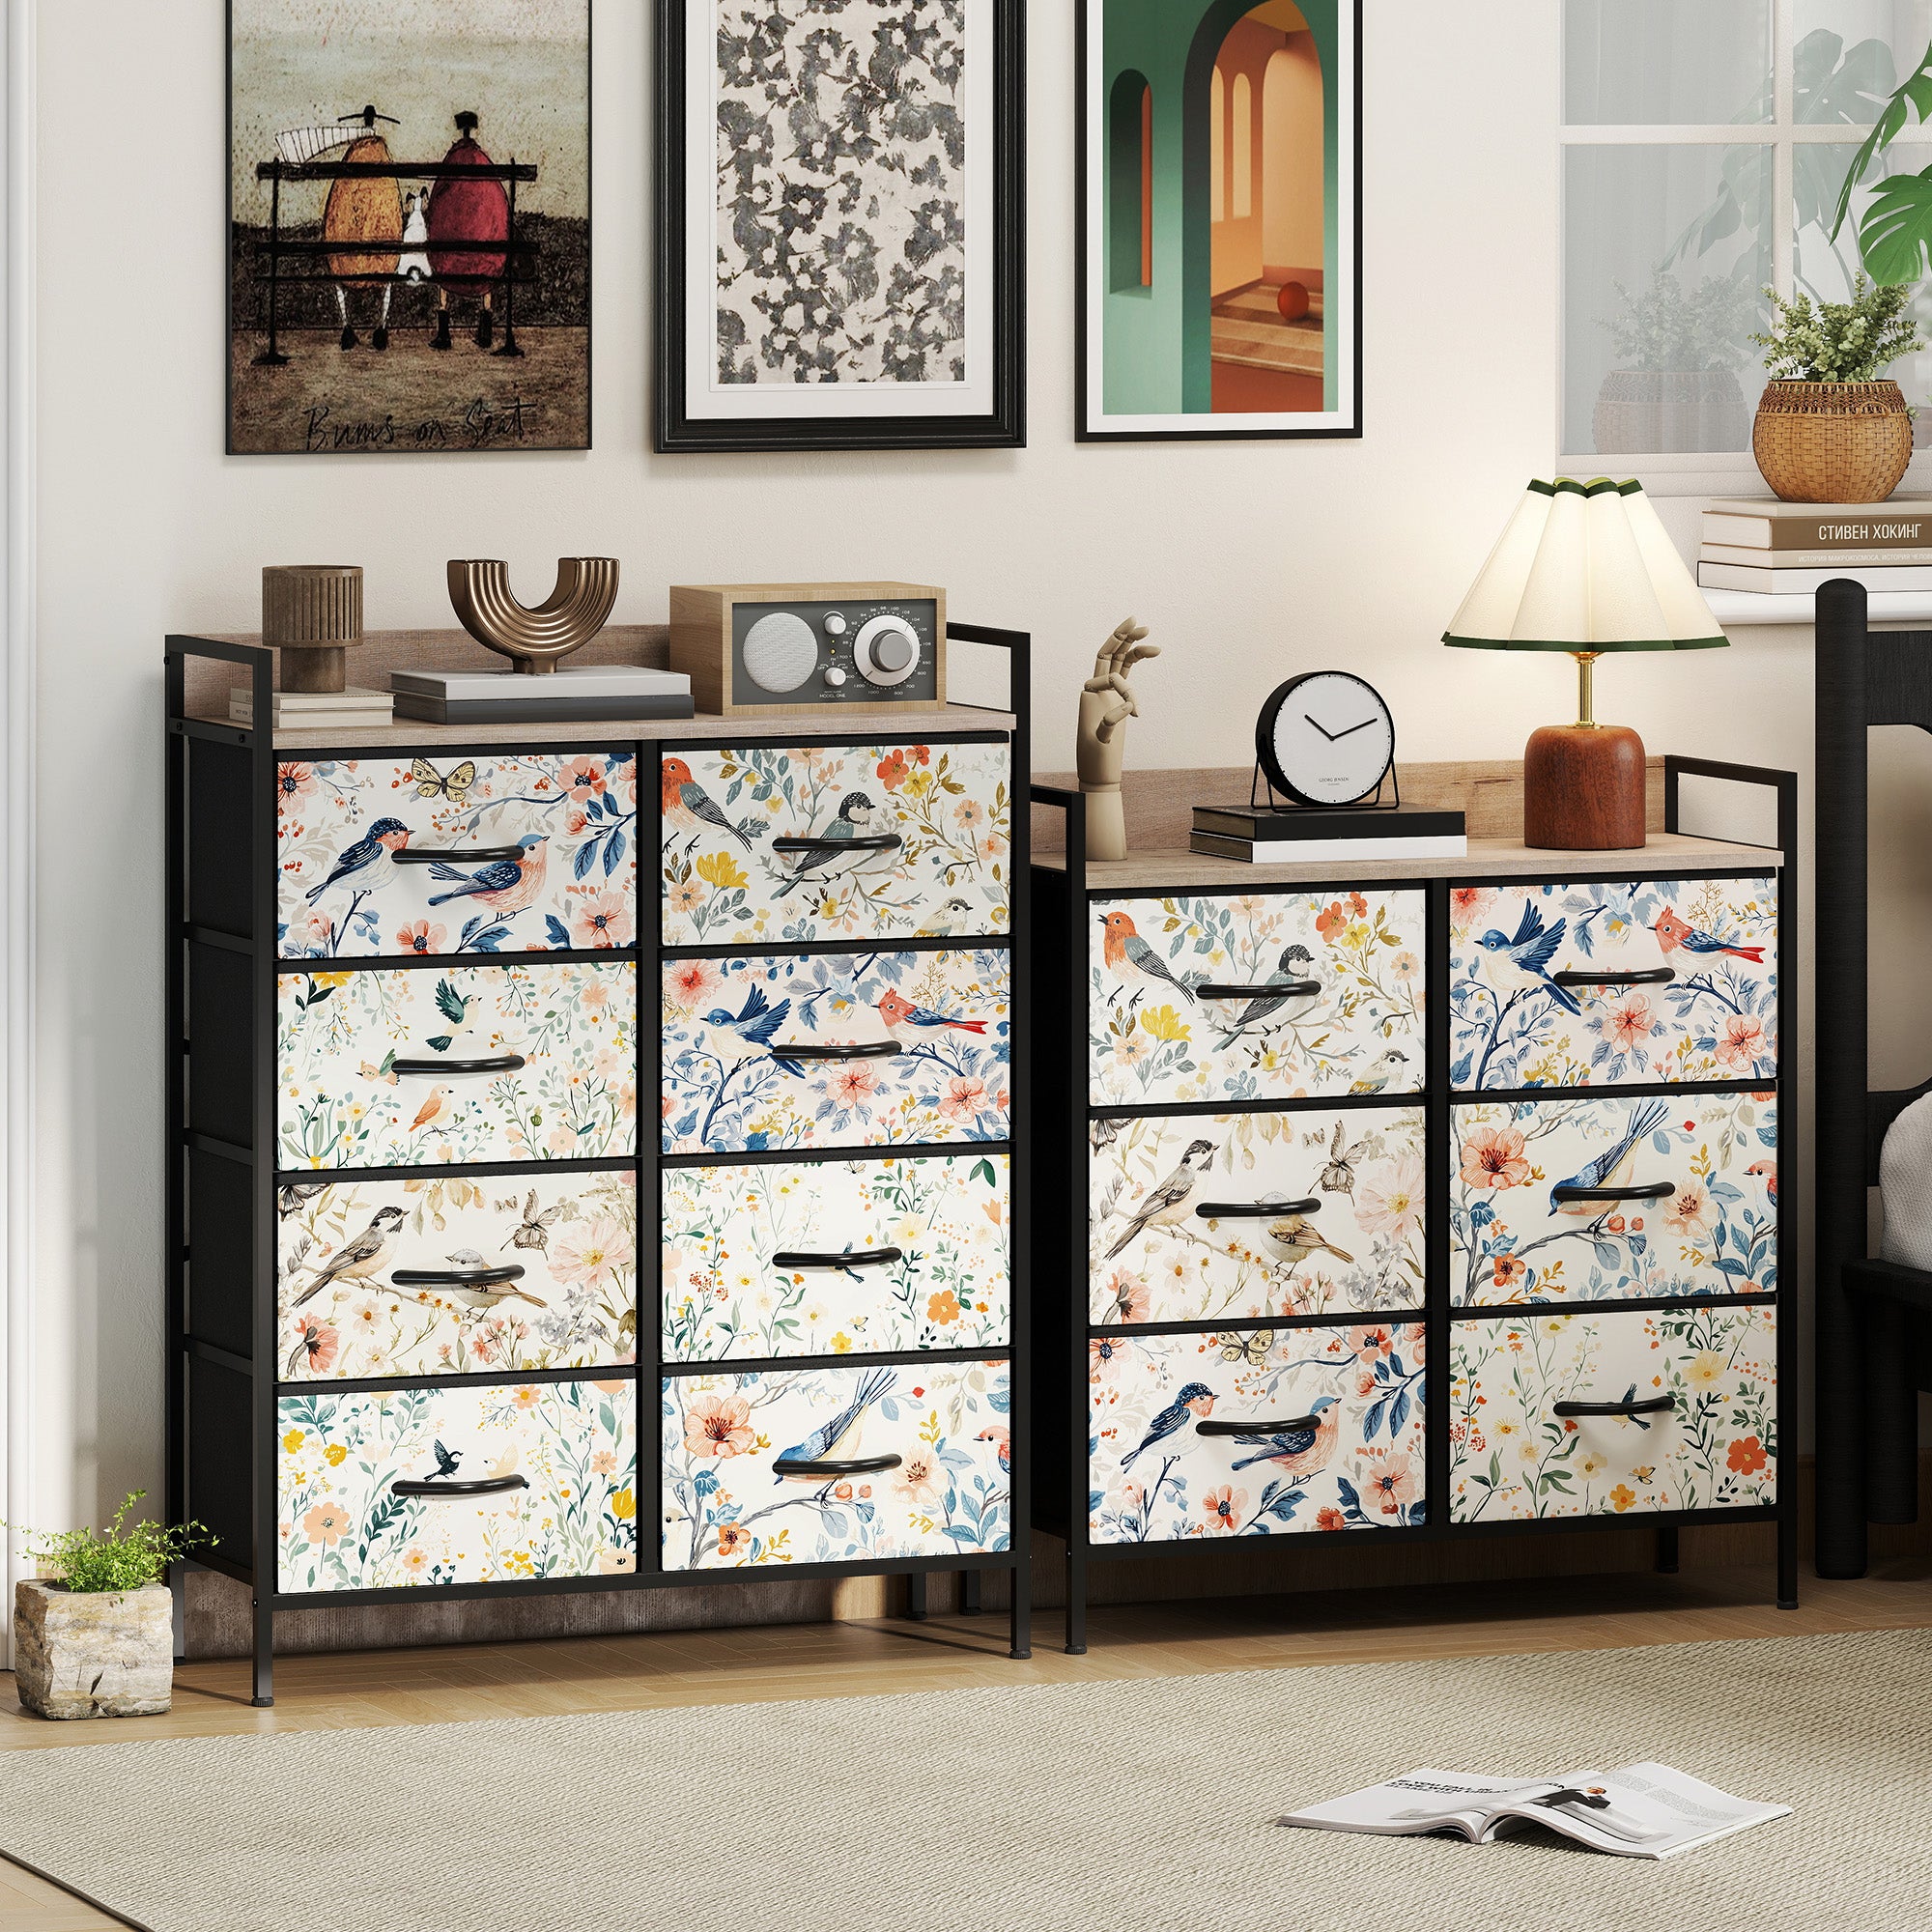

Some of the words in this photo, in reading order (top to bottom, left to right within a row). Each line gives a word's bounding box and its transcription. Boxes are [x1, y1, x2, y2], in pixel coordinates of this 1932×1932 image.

[302, 406, 394, 451] Bums
[415, 419, 446, 441] on
[466, 397, 537, 448] Seat
[1818, 525, 1868, 540] СТИВЕН
[1873, 524, 1921, 539] ХОКИНГ
